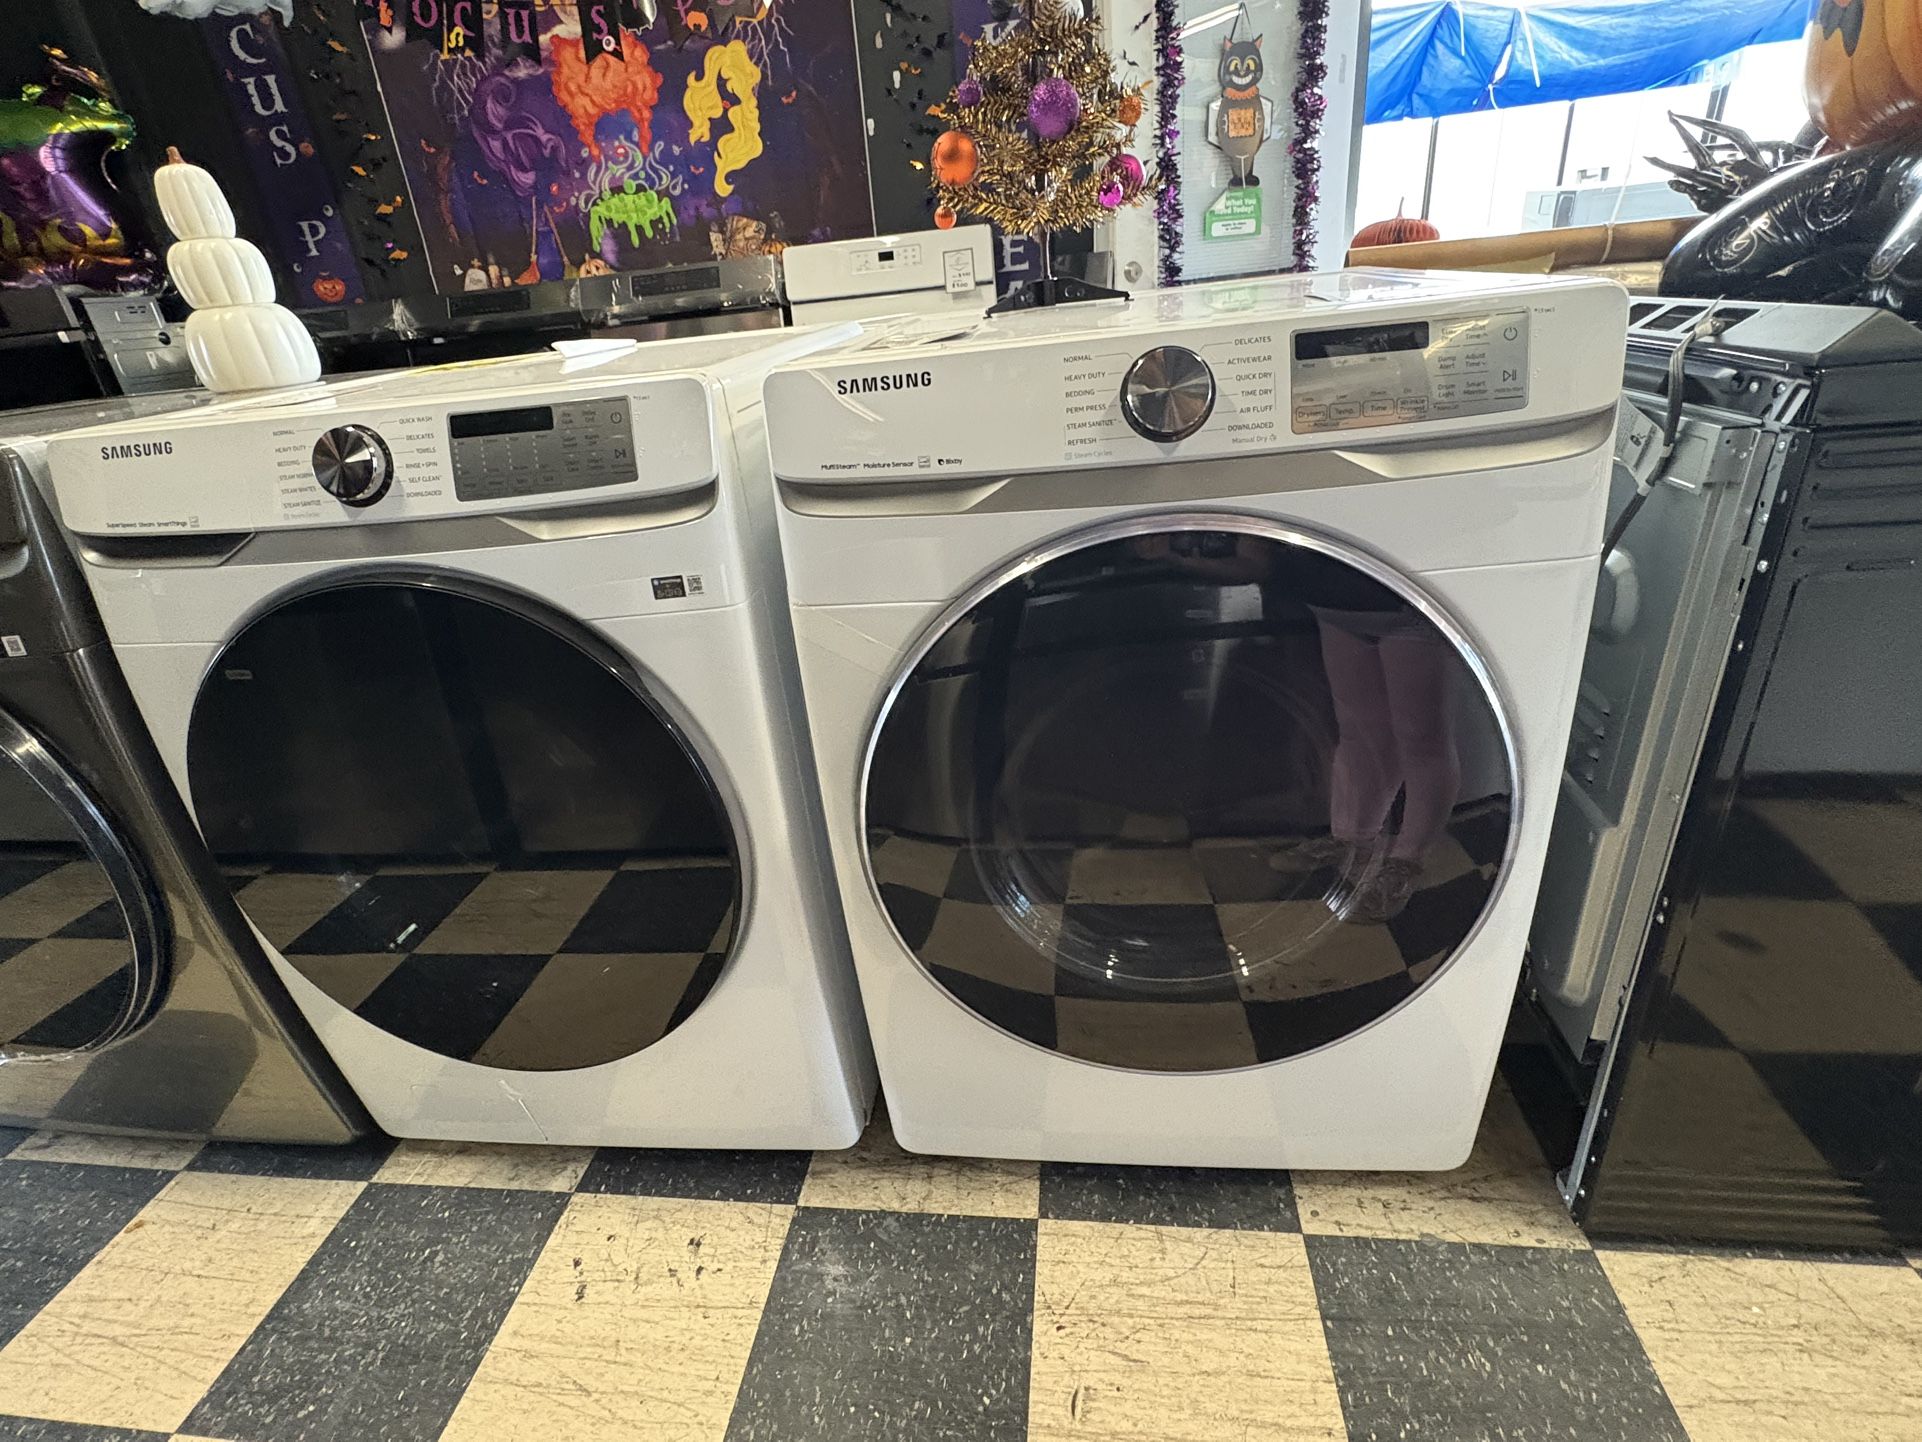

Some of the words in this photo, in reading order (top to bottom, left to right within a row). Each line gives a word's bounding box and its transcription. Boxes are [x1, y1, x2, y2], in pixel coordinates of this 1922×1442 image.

[1234, 335, 1272, 346] DELICATES
[1063, 354, 1093, 363] NORMAL
[1226, 354, 1273, 366] ACTIVEWEAR
[1064, 374, 1087, 382] HEAVY
[1087, 371, 1106, 379] DUTY
[1235, 373, 1257, 382] QUICK
[1258, 371, 1273, 380] DRY
[836, 371, 932, 395] SAMSUNG
[1065, 389, 1095, 398] BEDDING
[1258, 388, 1273, 396] DRY
[1066, 406, 1085, 414] PERM
[1085, 403, 1107, 412] PRESS
[1239, 406, 1252, 414] AIR
[1252, 404, 1273, 412] FLUFF
[1066, 422, 1087, 431] STEAM
[1227, 421, 1274, 432] DOWNLOADED
[1067, 437, 1097, 446] REFRESH
[101, 441, 173, 460] SAMSUNG
